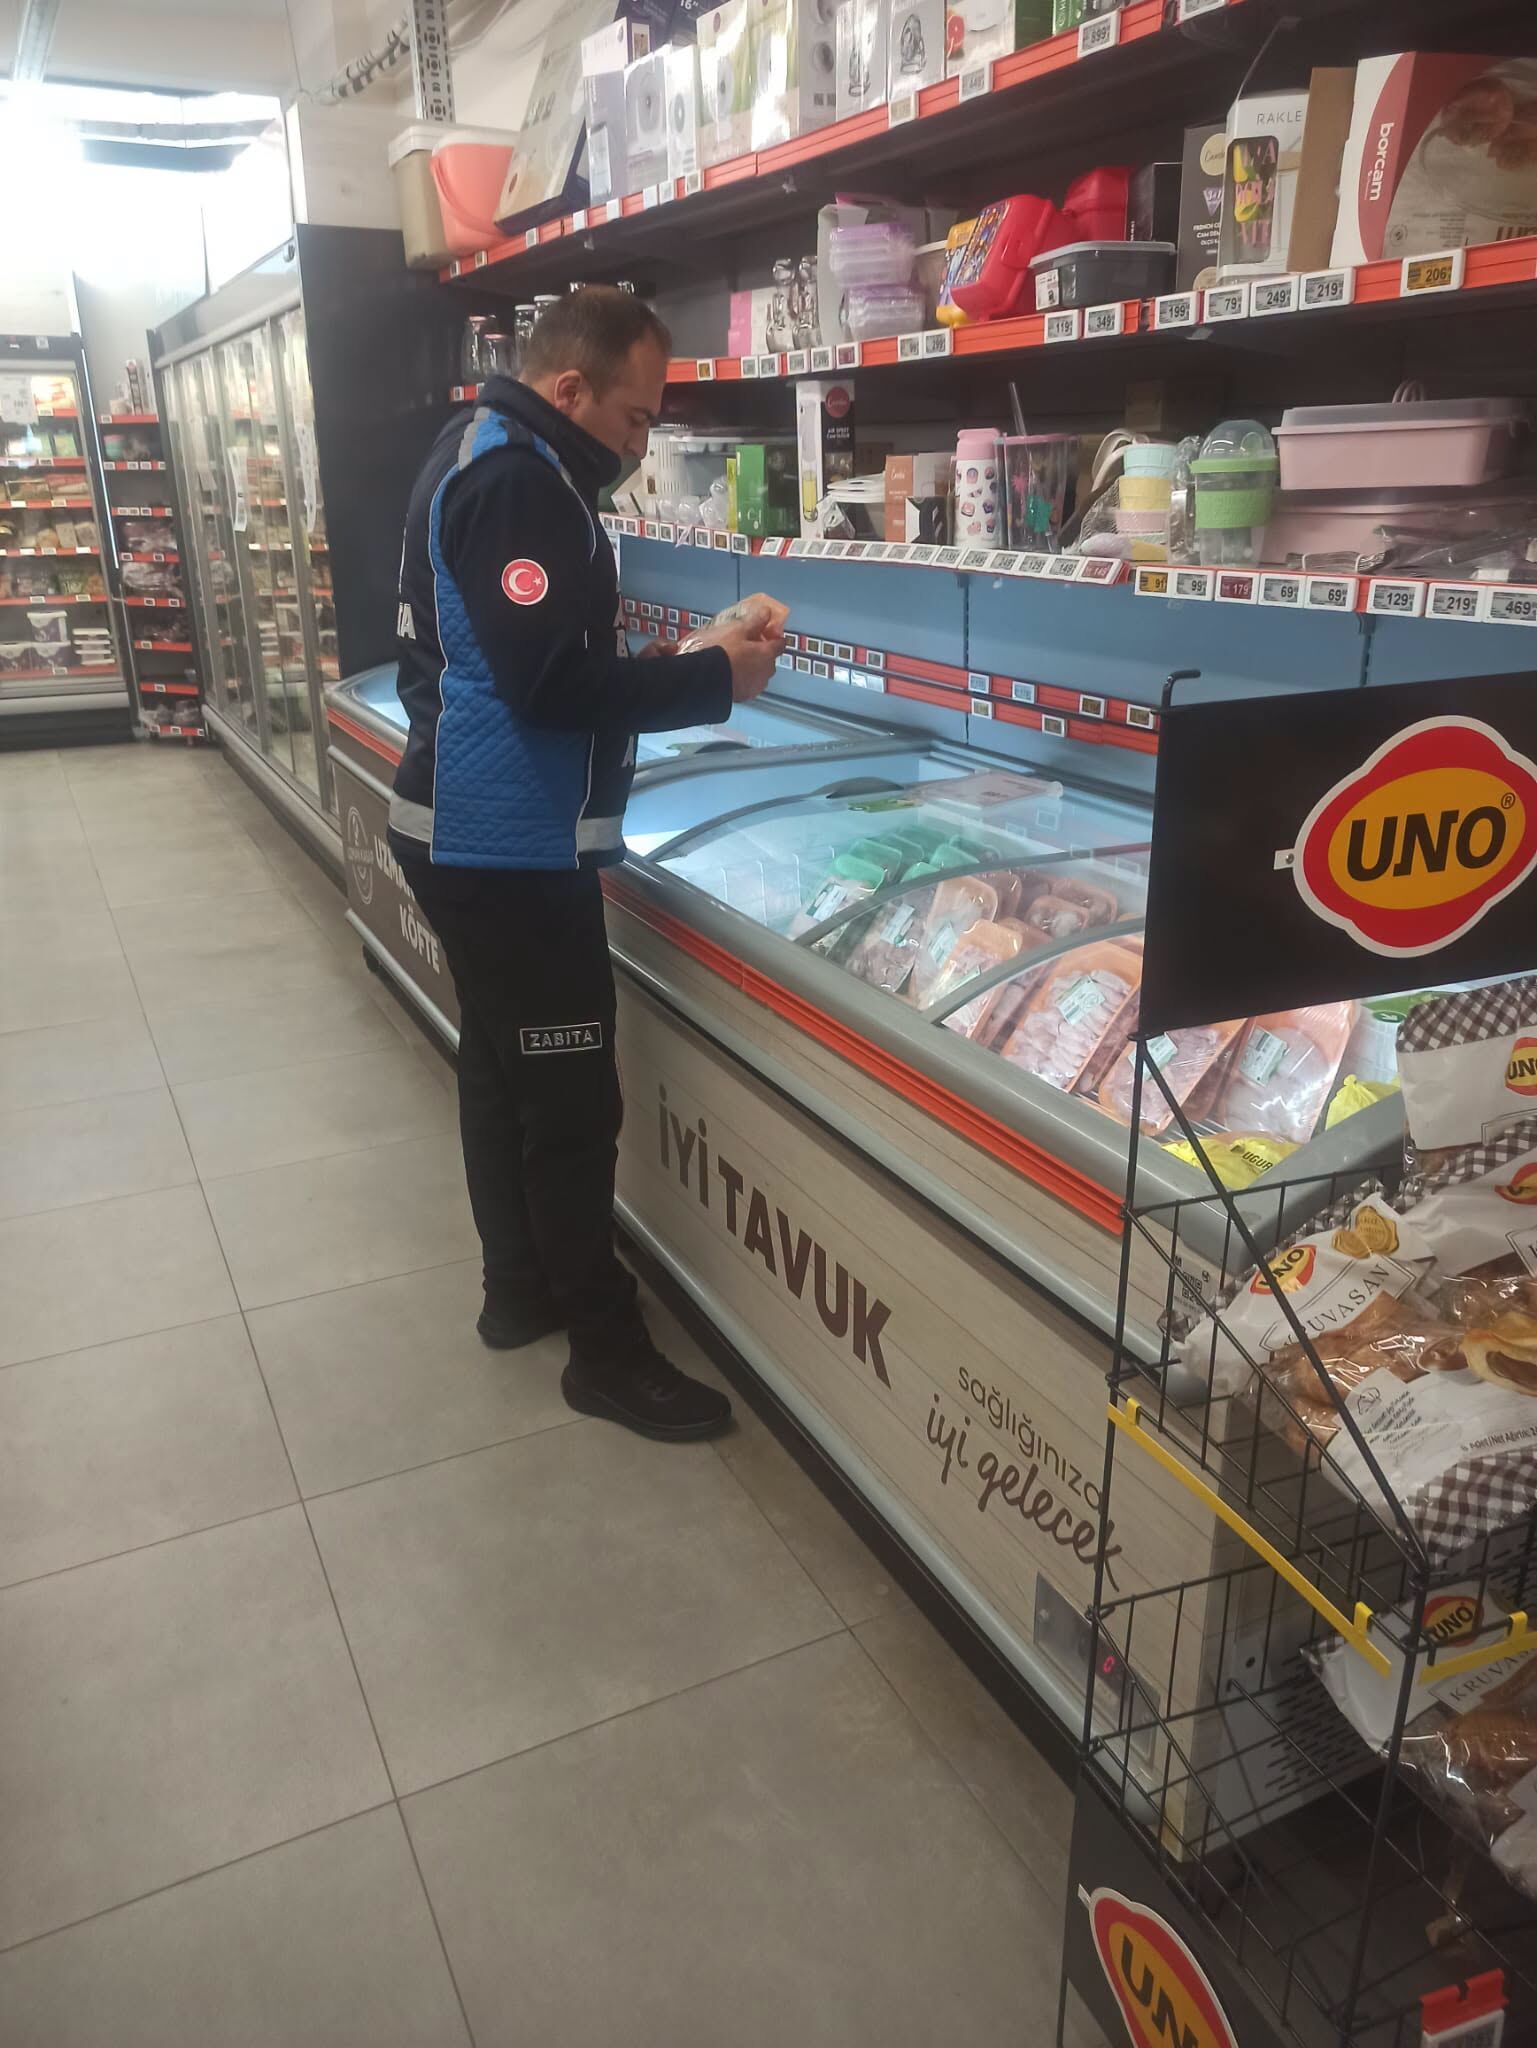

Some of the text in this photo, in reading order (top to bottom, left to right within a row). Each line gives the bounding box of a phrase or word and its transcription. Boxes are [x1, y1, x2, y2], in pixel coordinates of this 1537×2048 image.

[1256, 110, 1303, 125] RAKLE
[1369, 122, 1395, 201] borcam
[1424, 266, 1447, 283] 206
[1317, 282, 1338, 298] 219
[1280, 586, 1293, 598] 69
[1327, 588, 1341, 602] 69
[1386, 592, 1409, 606] 129
[1447, 596, 1471, 610] 219
[1505, 600, 1531, 615] 469
[1346, 805, 1507, 882] UNO
[400, 903, 440, 975] KÖFTE
[529, 1030, 594, 1048] ZABITA
[718, 1154, 892, 1391] TAVUK
[1284, 1264, 1390, 1347] UVASAN
[926, 1393, 1123, 1593] iyi gelecek
[1432, 1606, 1474, 1641] UNO
[1450, 1651, 1529, 1701] KRUVA
